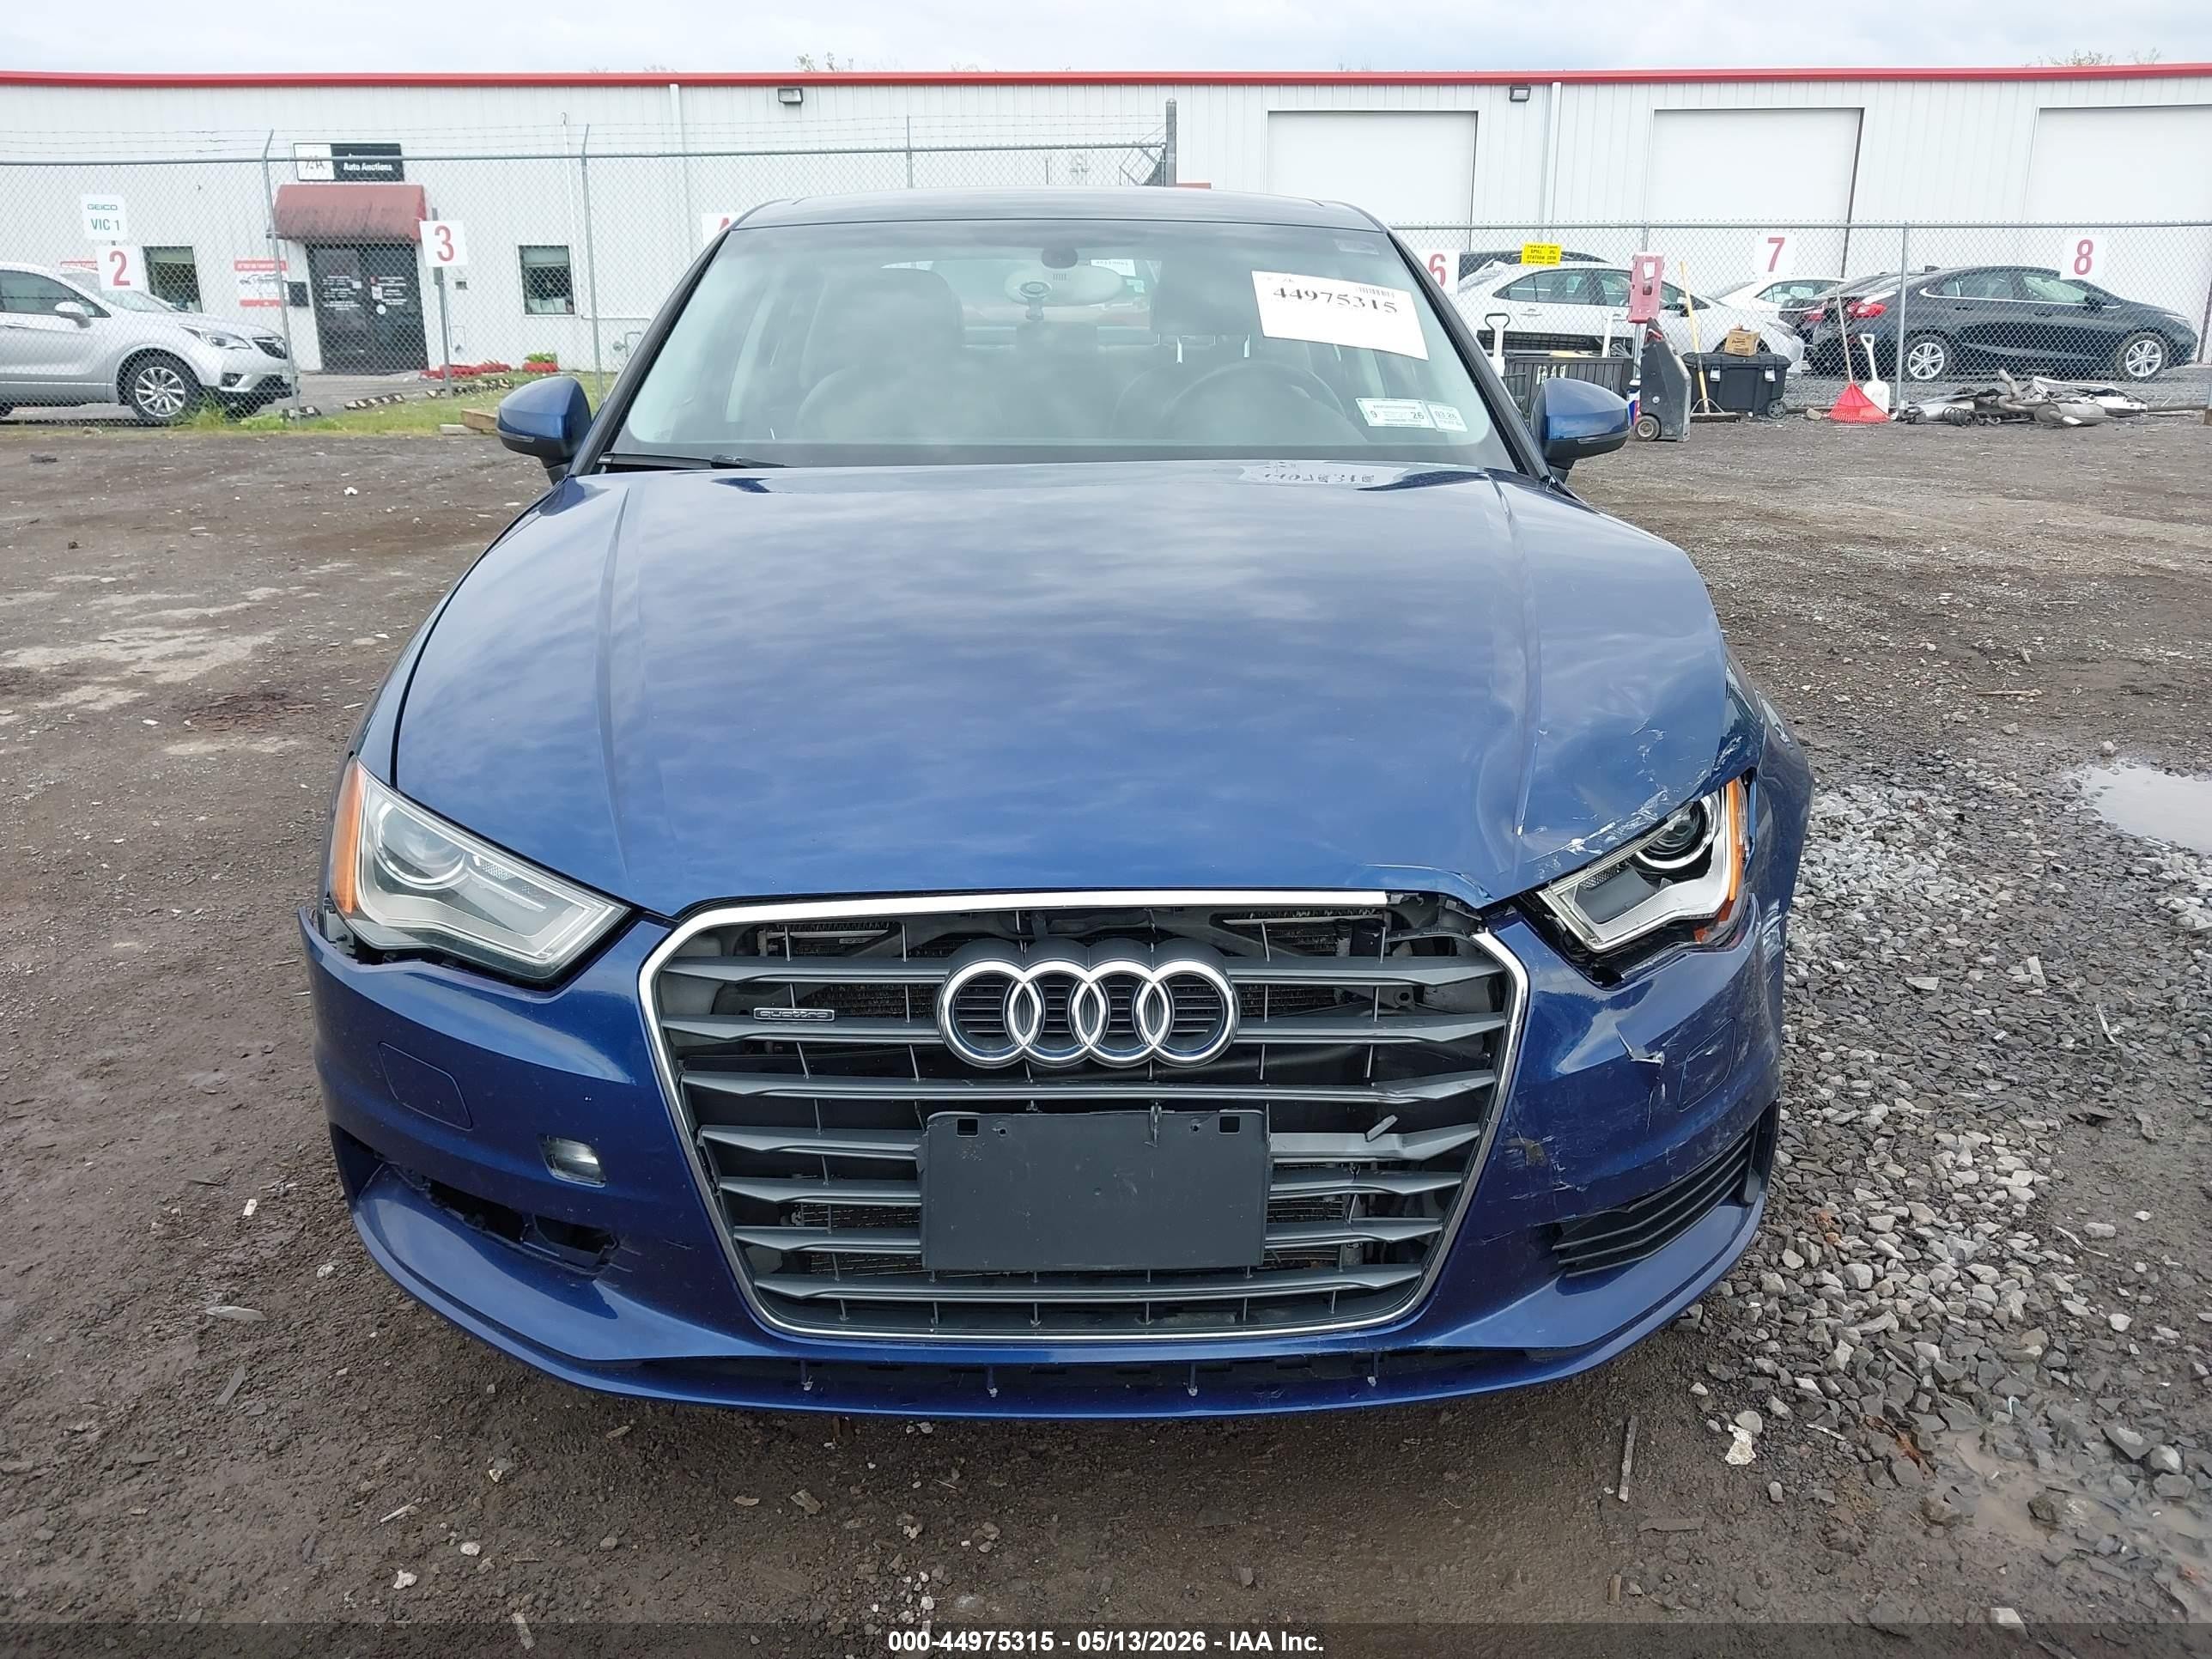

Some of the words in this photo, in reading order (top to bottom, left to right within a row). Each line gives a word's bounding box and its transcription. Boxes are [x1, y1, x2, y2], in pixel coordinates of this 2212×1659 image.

[343, 162, 360, 171] Auto
[361, 162, 392, 171] Auctions
[90, 218, 110, 230] VIC
[114, 219, 119, 230] 1
[434, 225, 454, 261] 3
[1768, 237, 1785, 272] 7
[2074, 239, 2094, 275] 8
[109, 251, 131, 286] 2
[1429, 253, 1446, 287] 6
[1273, 288, 1398, 313] 44975315
